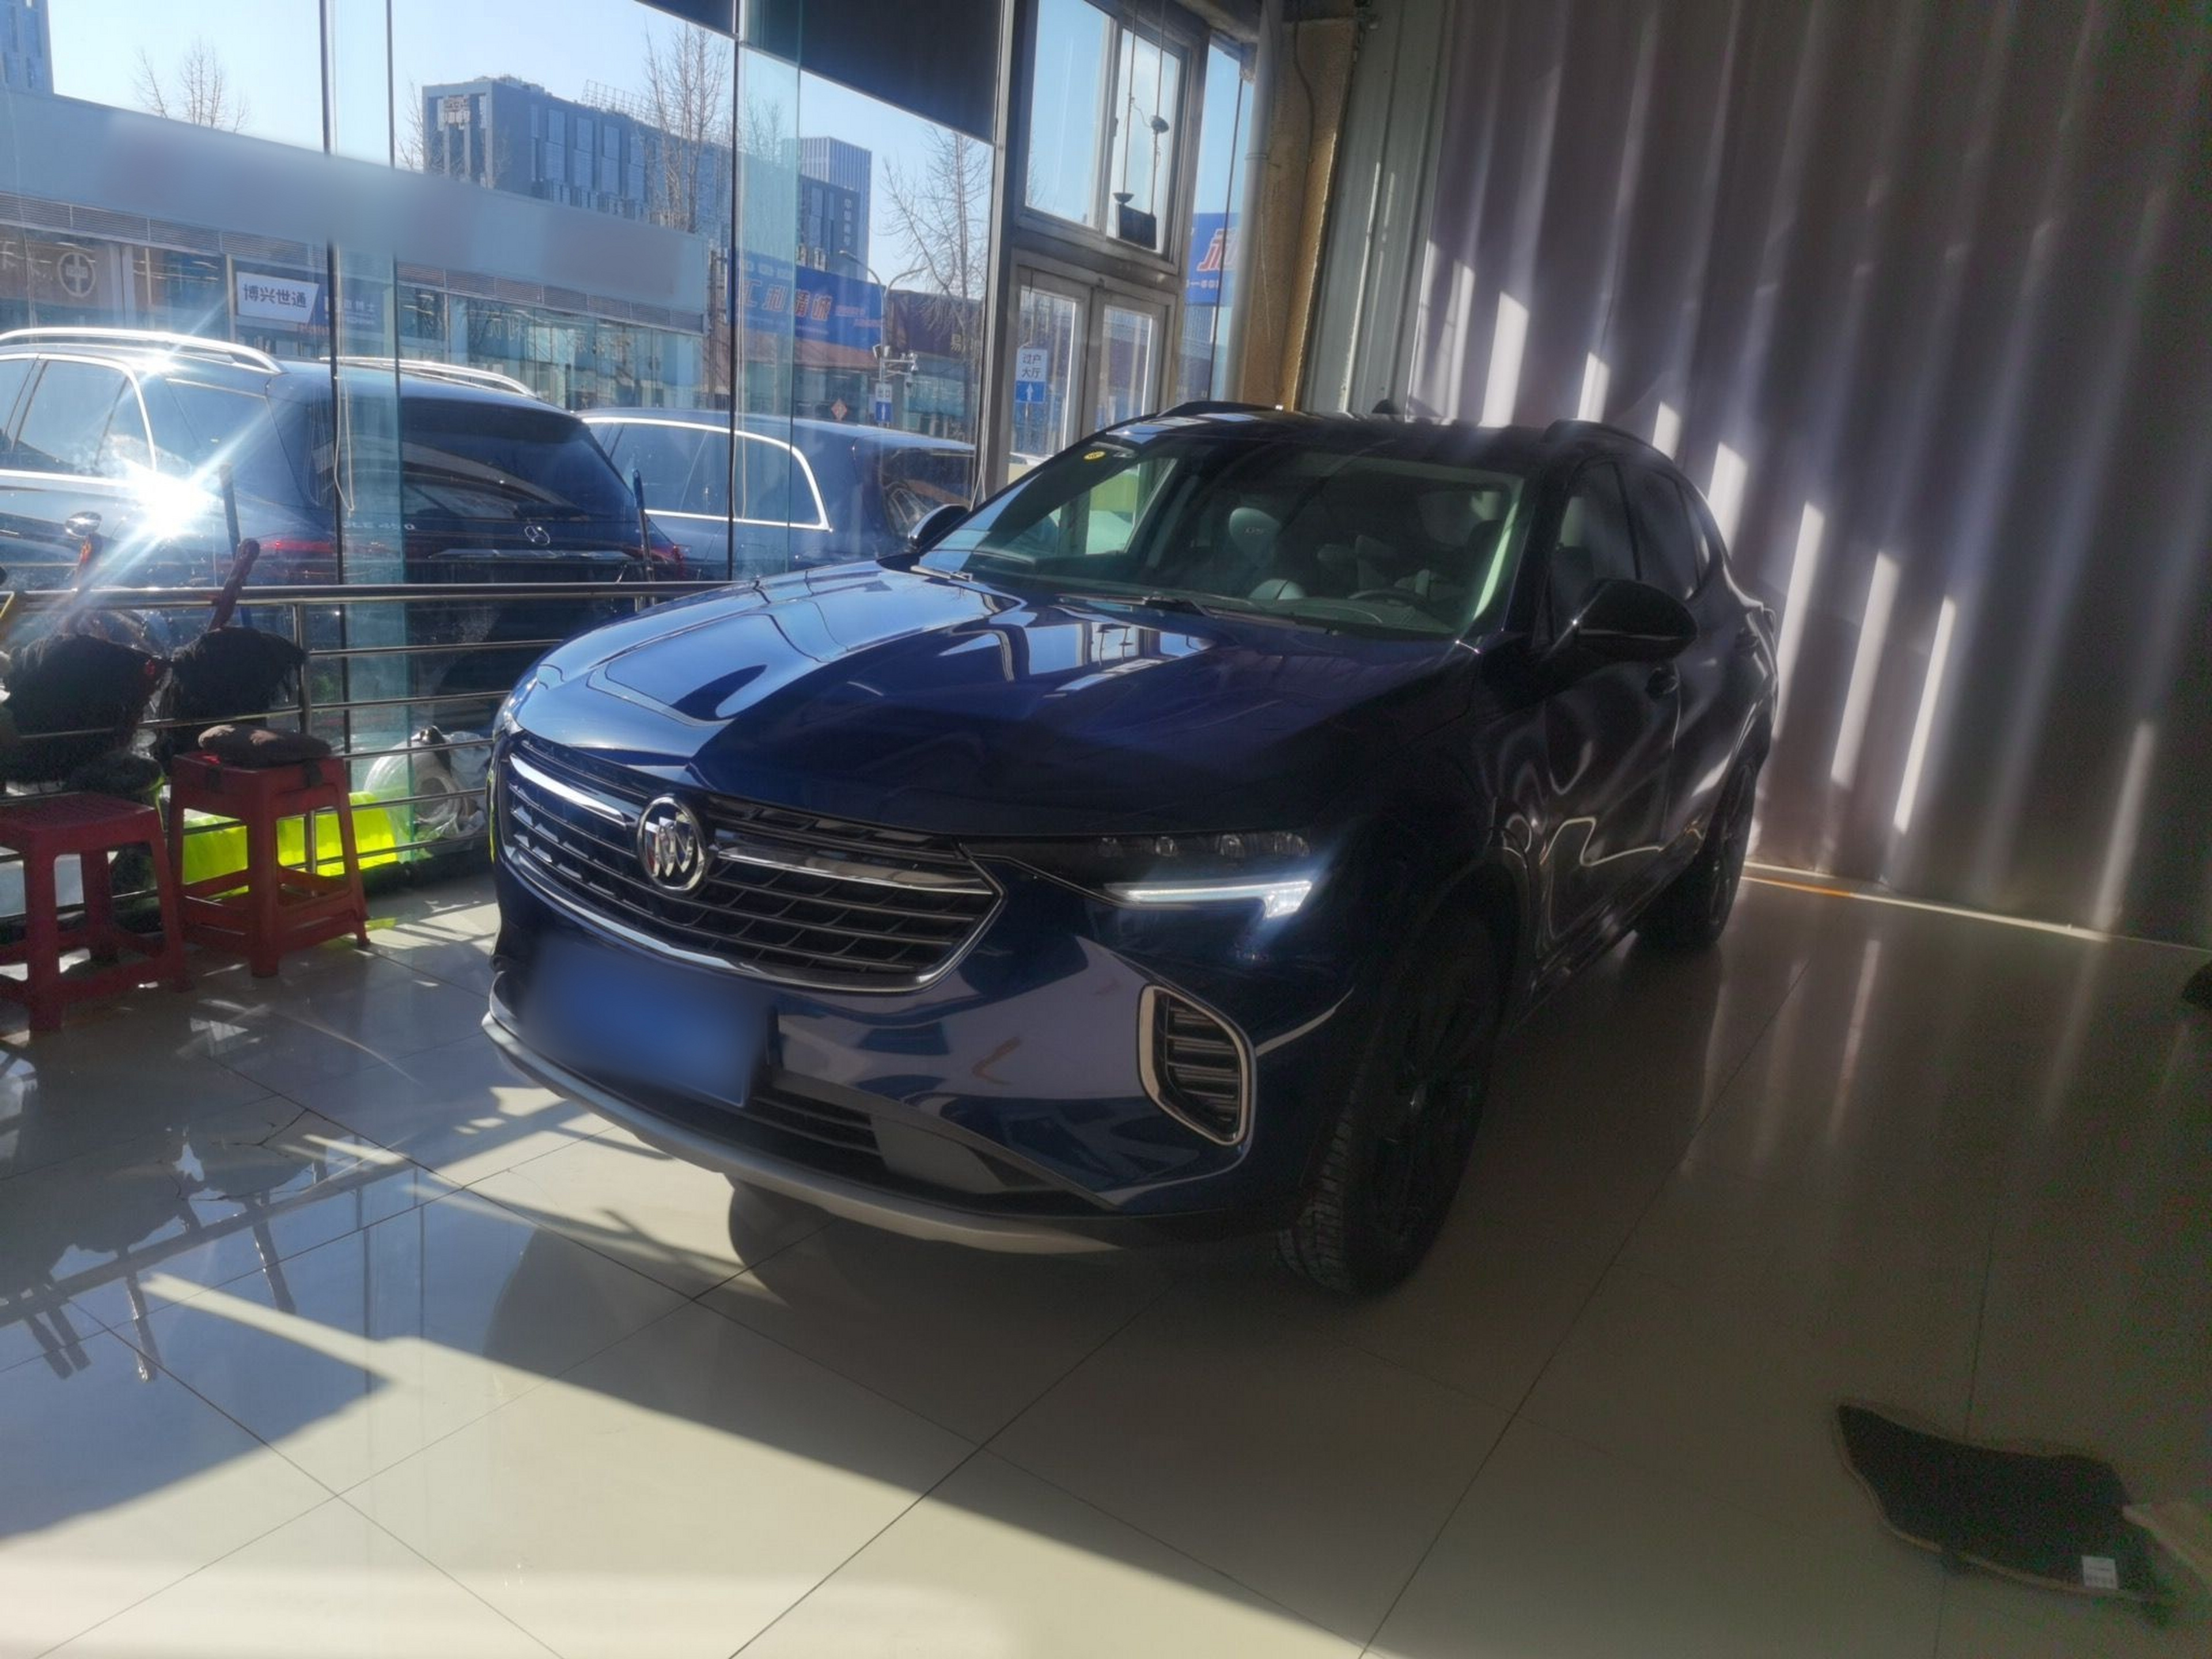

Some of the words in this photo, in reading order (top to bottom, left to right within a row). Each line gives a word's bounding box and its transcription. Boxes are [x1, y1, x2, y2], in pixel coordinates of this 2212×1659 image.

[243, 283, 307, 308] 博兴世通
[1022, 353, 1041, 365] 过户
[1021, 367, 1042, 378] 大厅
